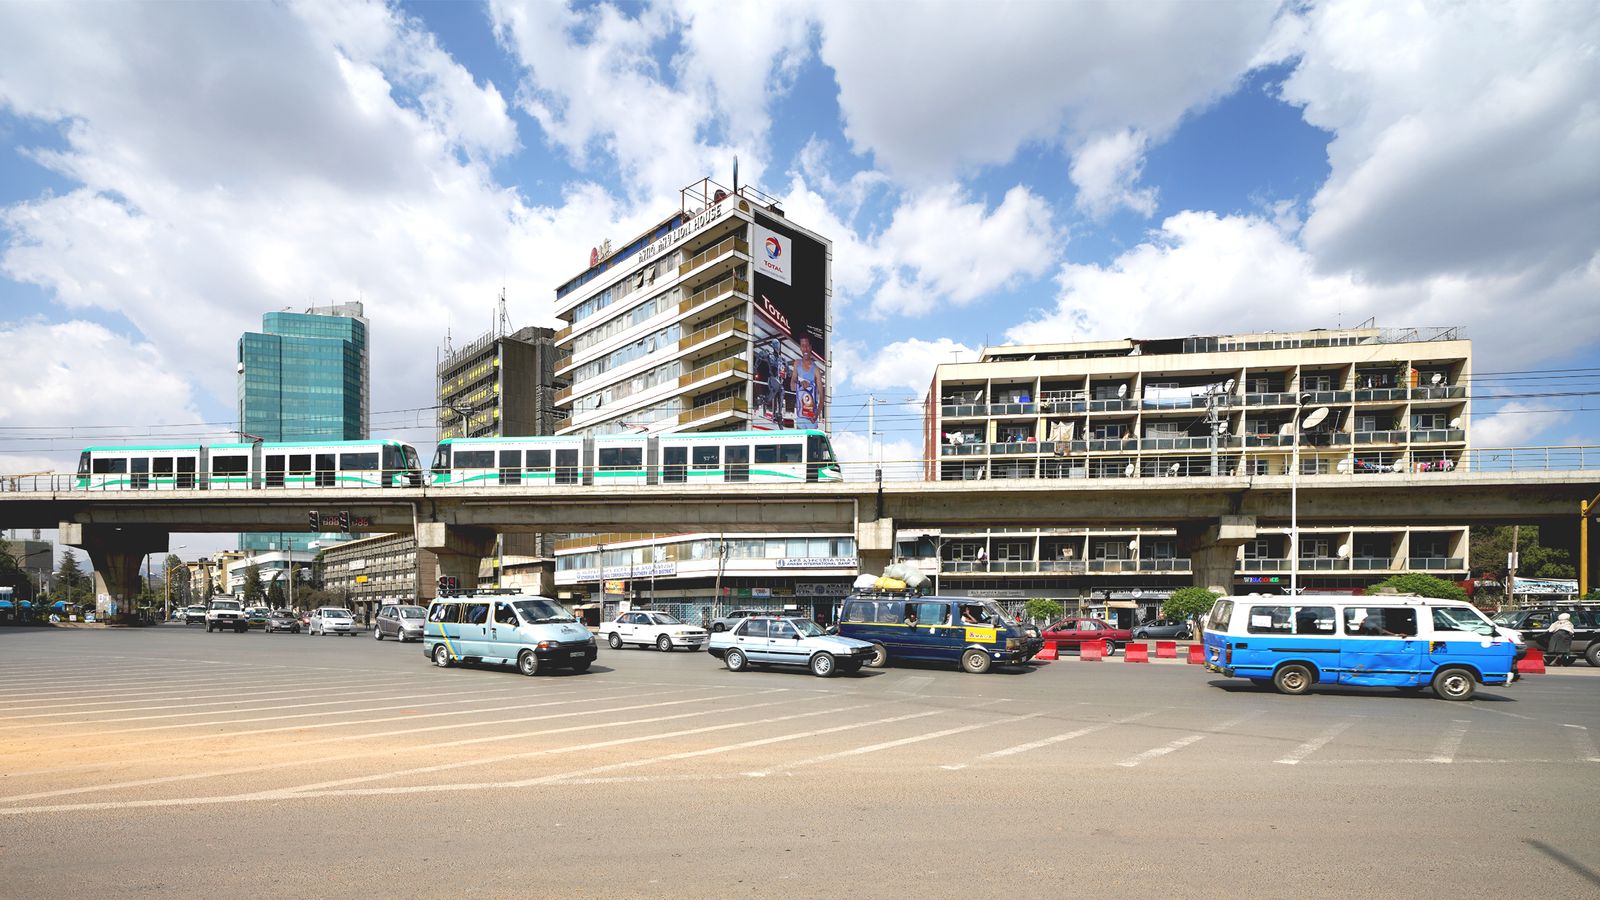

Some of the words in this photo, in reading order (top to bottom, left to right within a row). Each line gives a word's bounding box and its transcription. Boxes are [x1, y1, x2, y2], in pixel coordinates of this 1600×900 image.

[673, 223, 691, 243] LION
[694, 204, 722, 231] HOUSE
[764, 260, 783, 273] TOTAL
[761, 294, 791, 329] TOTAL
